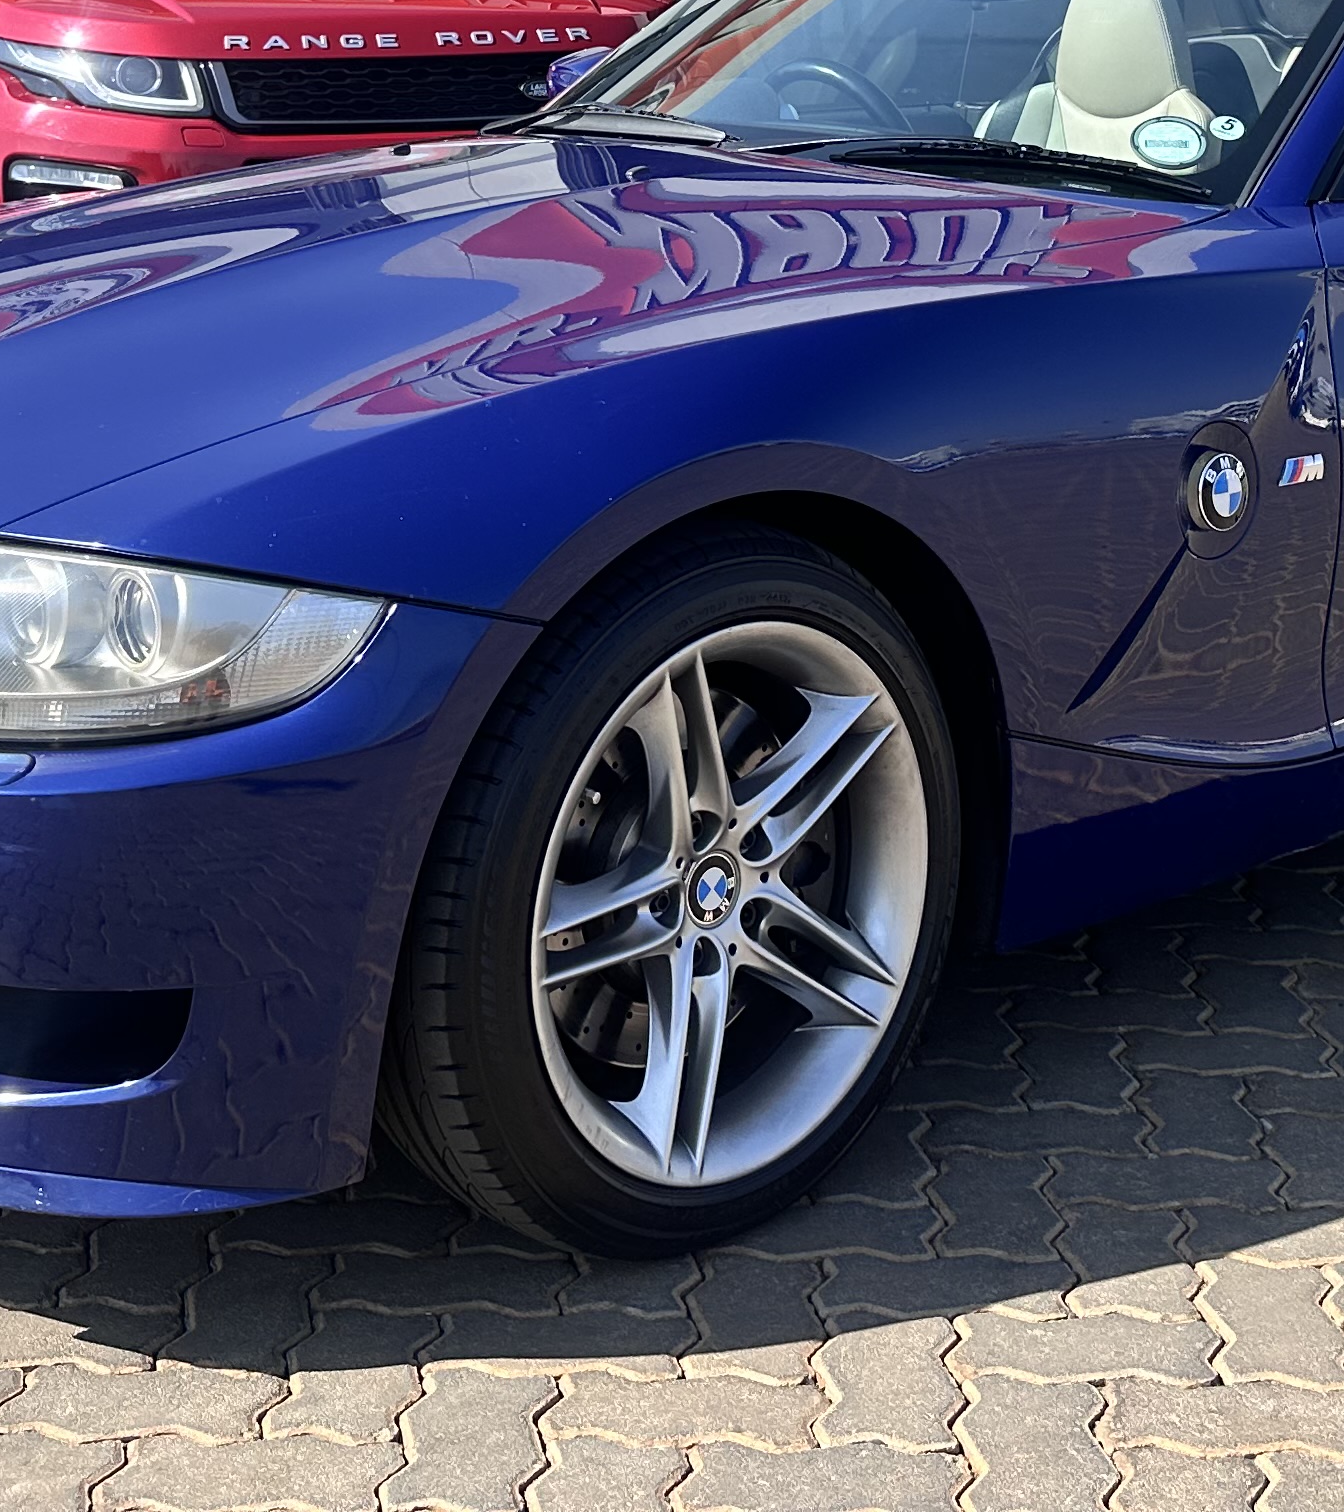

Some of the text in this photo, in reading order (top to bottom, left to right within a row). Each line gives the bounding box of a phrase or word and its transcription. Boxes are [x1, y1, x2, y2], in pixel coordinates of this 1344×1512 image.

[223, 26, 592, 51] RANGE ROVER
[1220, 118, 1238, 131] 5
